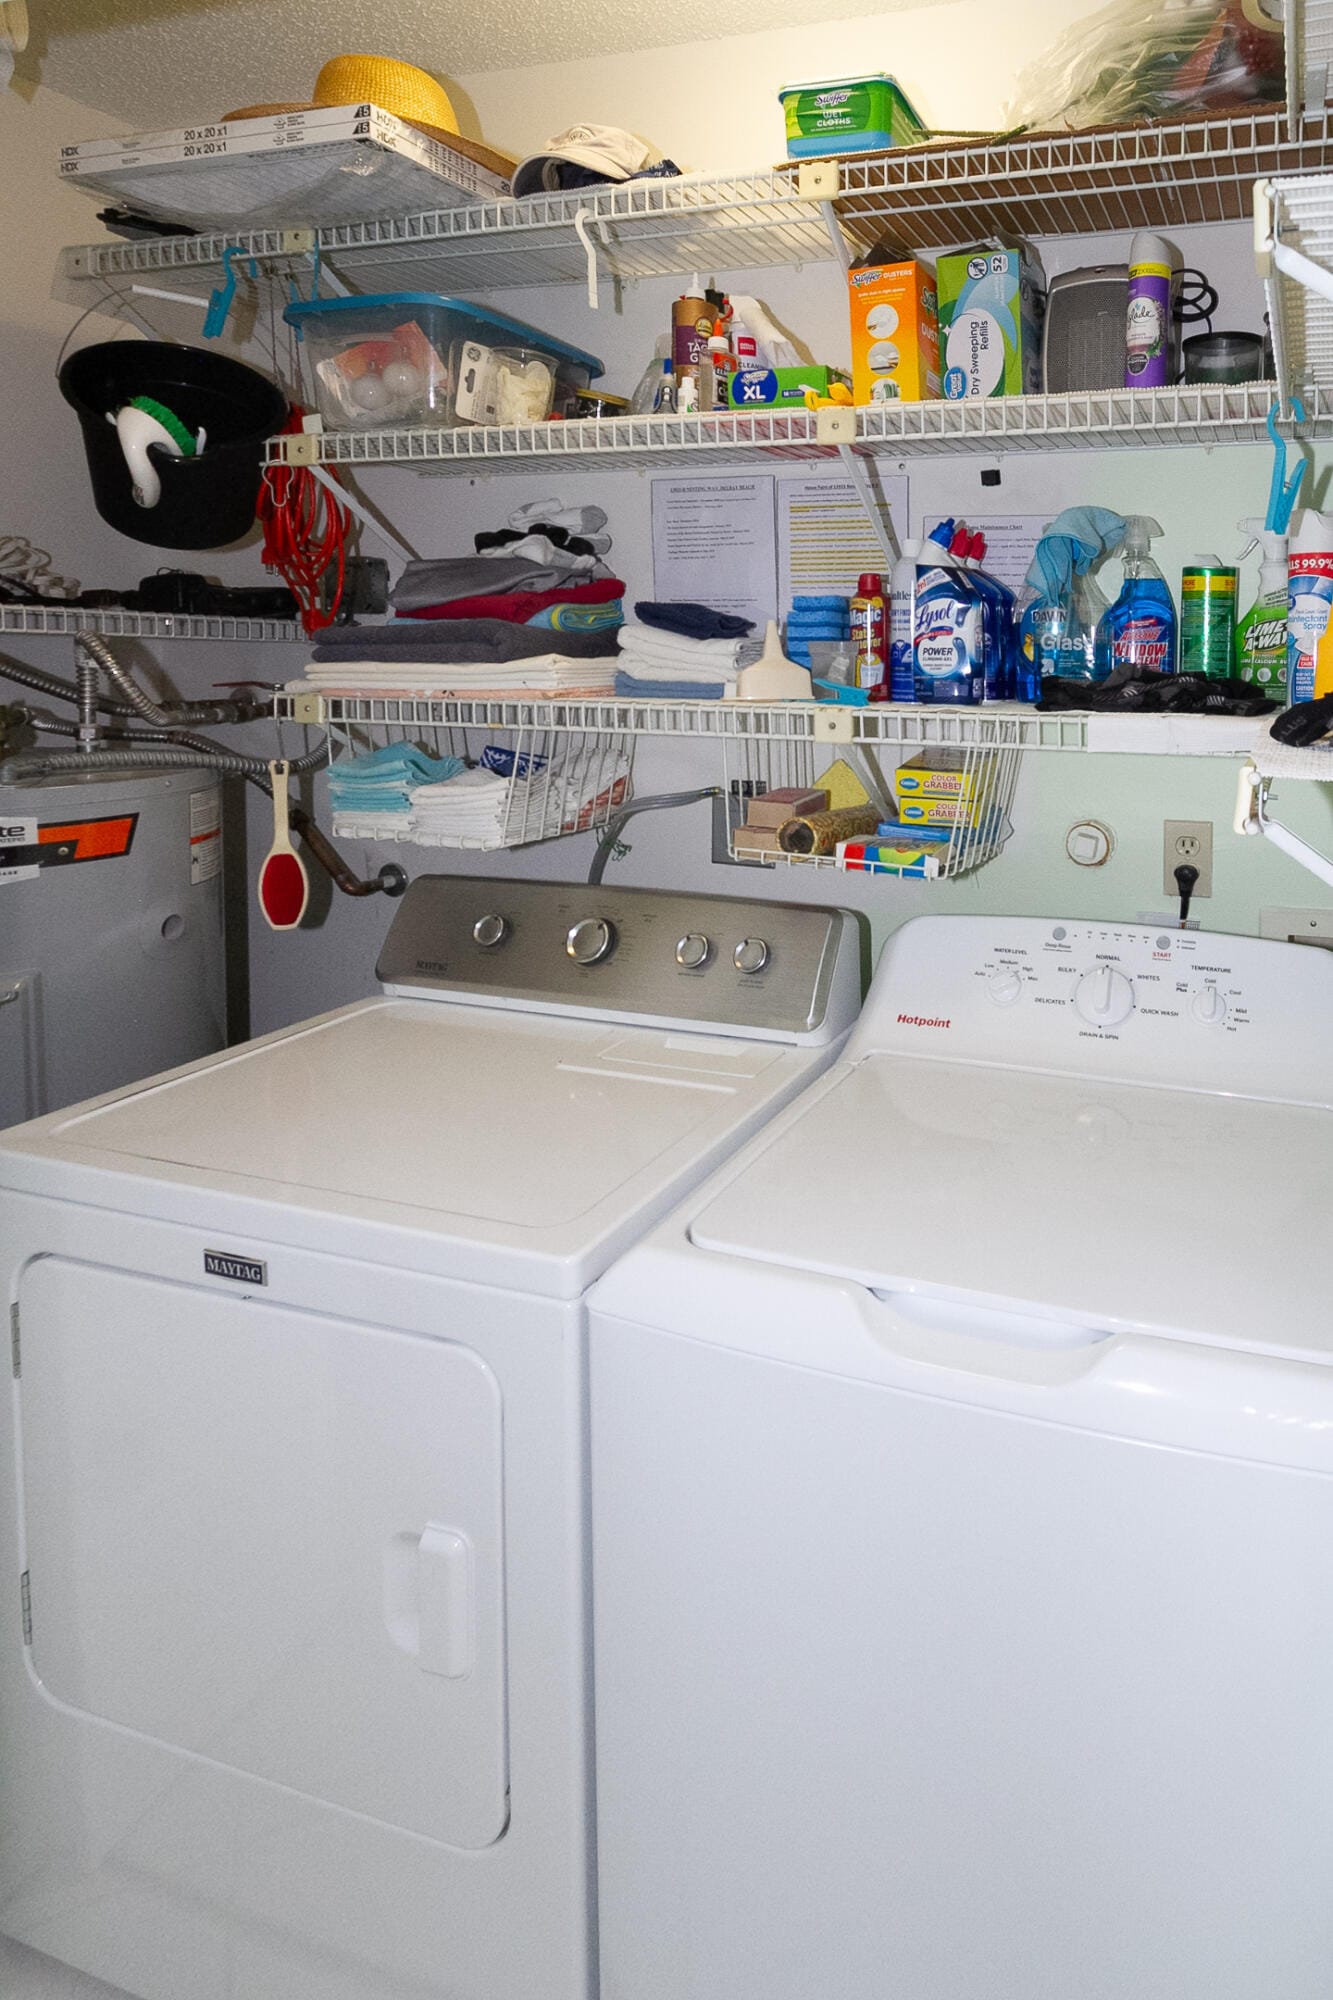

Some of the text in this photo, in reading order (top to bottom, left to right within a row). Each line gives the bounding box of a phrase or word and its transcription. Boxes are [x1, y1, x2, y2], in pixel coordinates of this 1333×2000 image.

[816, 91, 849, 107] Swiffer
[816, 118, 851, 127] CLOTHS
[184, 130, 195, 140] 20
[204, 127, 216, 138] 20
[61, 146, 80, 157] HDX
[184, 146, 195, 156] 20
[204, 143, 215, 154] 20
[60, 162, 79, 173] HDX
[992, 256, 1002, 272] 52
[852, 269, 913, 285] Swiffer DUSTERS
[981, 320, 989, 350] Refills
[970, 321, 982, 395] Dry Sweeping
[744, 385, 766, 400] XL
[915, 600, 954, 631] Lysol
[1032, 610, 1068, 623] DAWN
[1303, 623, 1326, 632] Spray
[852, 628, 875, 641] Statc
[923, 647, 953, 656] POWER
[1114, 642, 1168, 657] WINDOW
[1191, 965, 1232, 973] TEMPERATURE
[1034, 998, 1066, 1006] DELICATES
[897, 1014, 951, 1028] Hotpoint
[206, 1257, 260, 1280] MAYTAG
